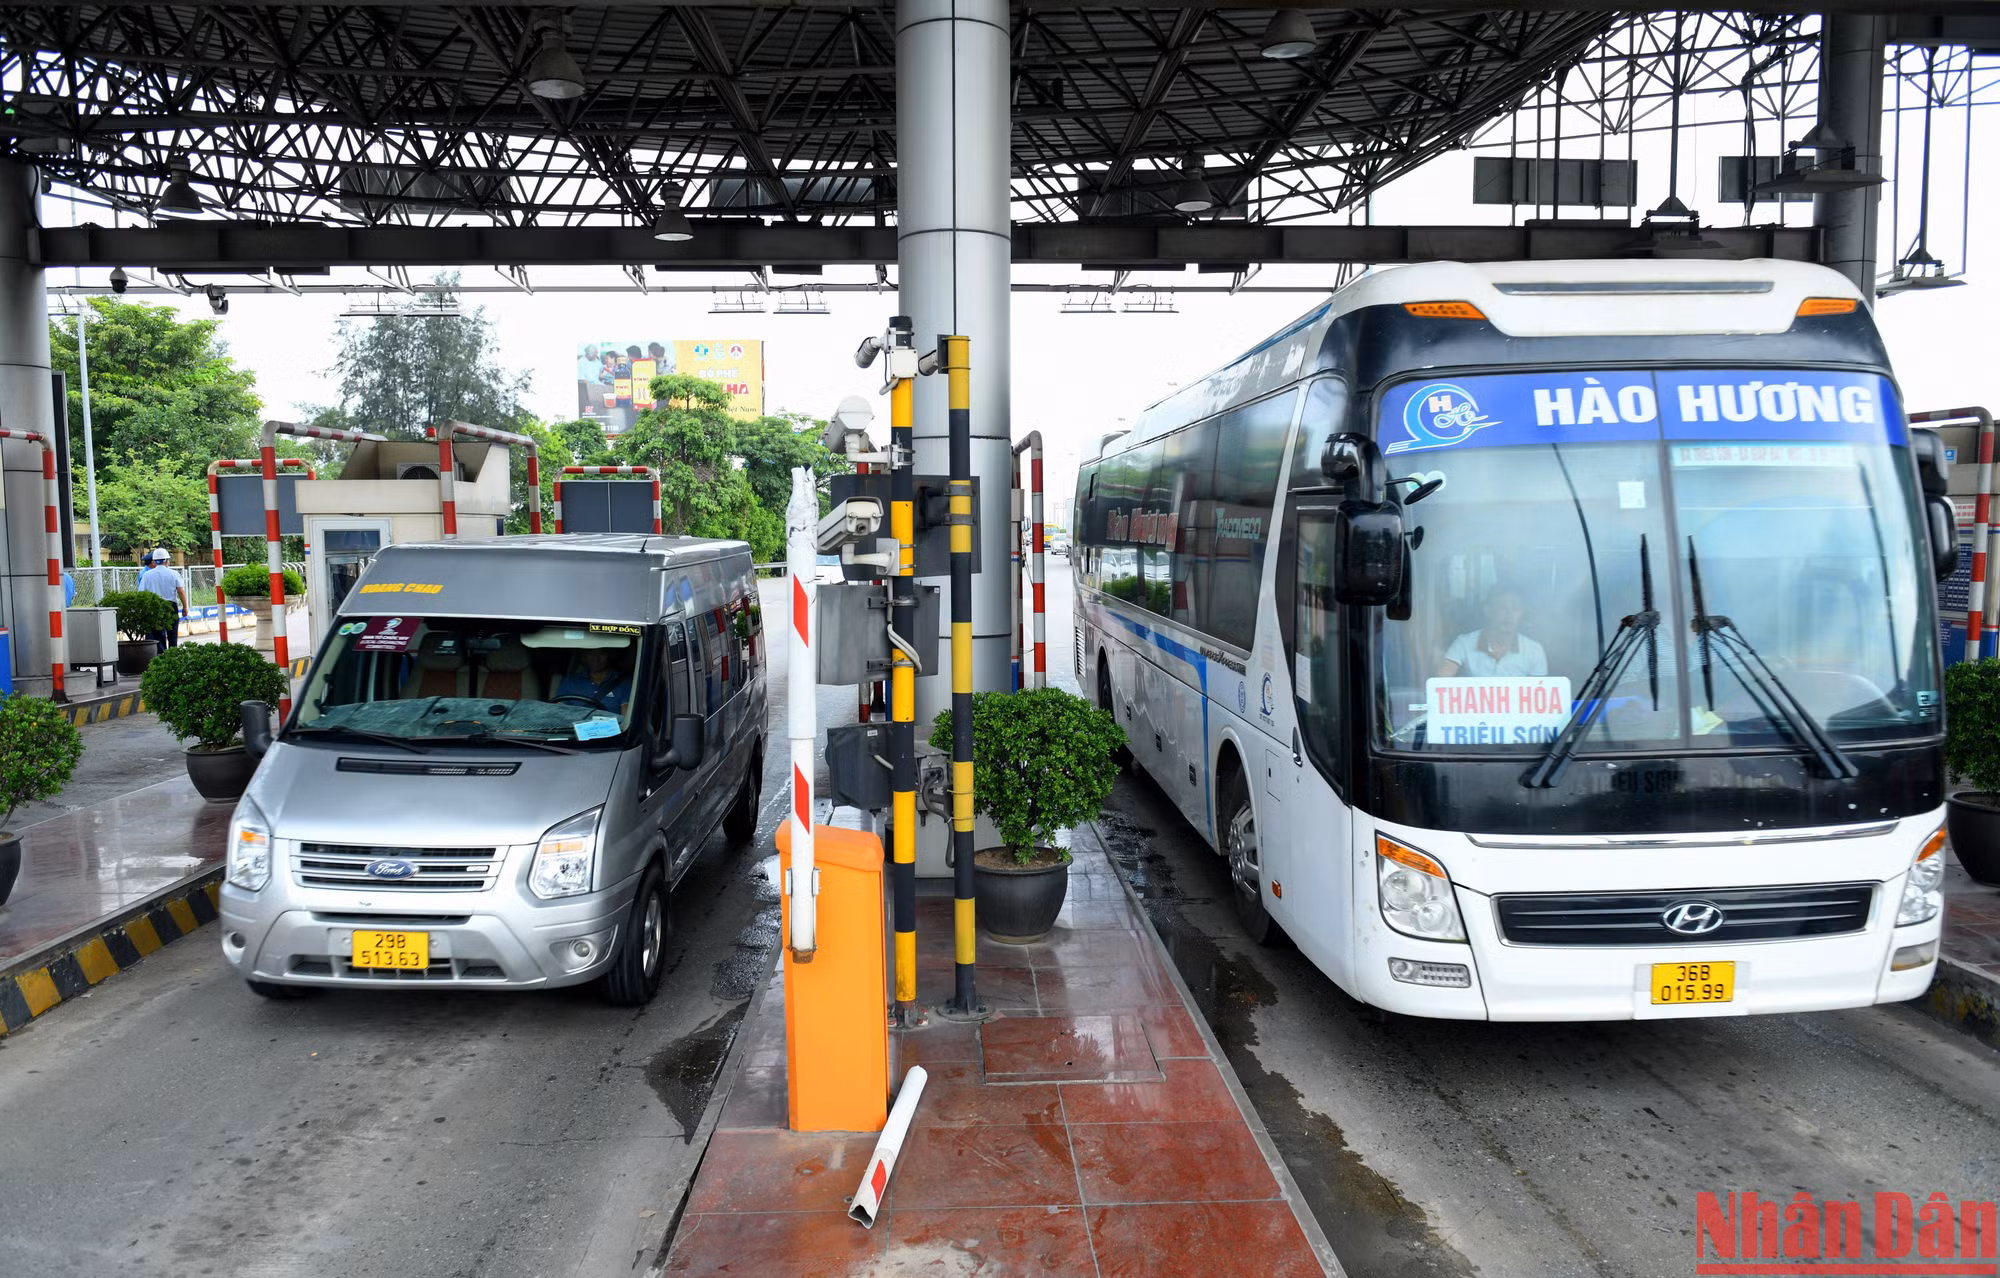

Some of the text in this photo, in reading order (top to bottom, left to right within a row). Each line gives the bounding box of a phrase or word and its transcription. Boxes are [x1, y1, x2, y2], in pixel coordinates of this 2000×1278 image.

[1533, 377, 1876, 426] HÀO HƯƠNG
[1129, 507, 1179, 552] Hương
[1435, 680, 1563, 714] THANH HÓA
[1513, 723, 1559, 744] SƠN
[374, 862, 405, 875] Ford
[375, 933, 406, 948] 29B
[361, 950, 419, 966] 513.63
[1677, 965, 1710, 981] 36B
[1661, 984, 1724, 1001] 015.99
